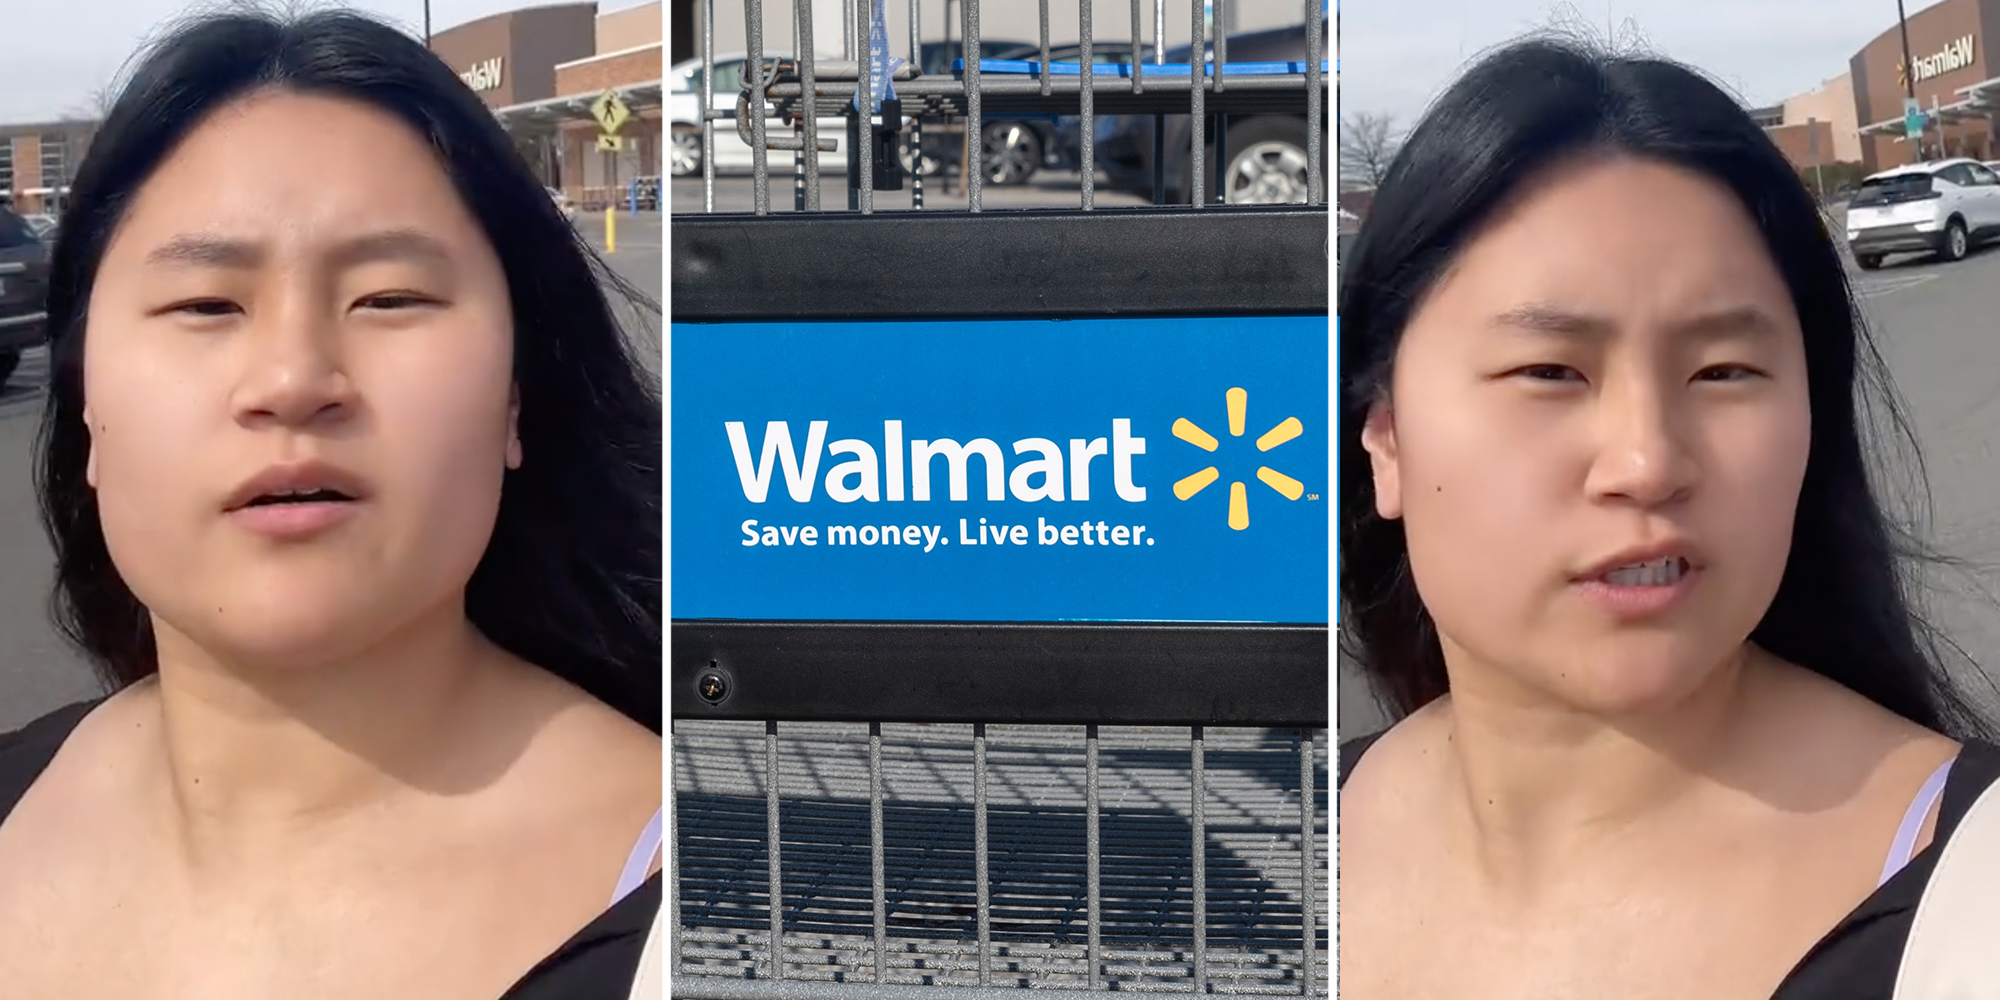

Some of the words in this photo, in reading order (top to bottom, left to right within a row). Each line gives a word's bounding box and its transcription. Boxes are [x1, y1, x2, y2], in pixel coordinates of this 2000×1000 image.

[724, 418, 1147, 504] Walmart
[741, 519, 819, 547] Save
[827, 525, 949, 554] money.
[959, 517, 1029, 546] Live
[1037, 517, 1155, 546] better.
